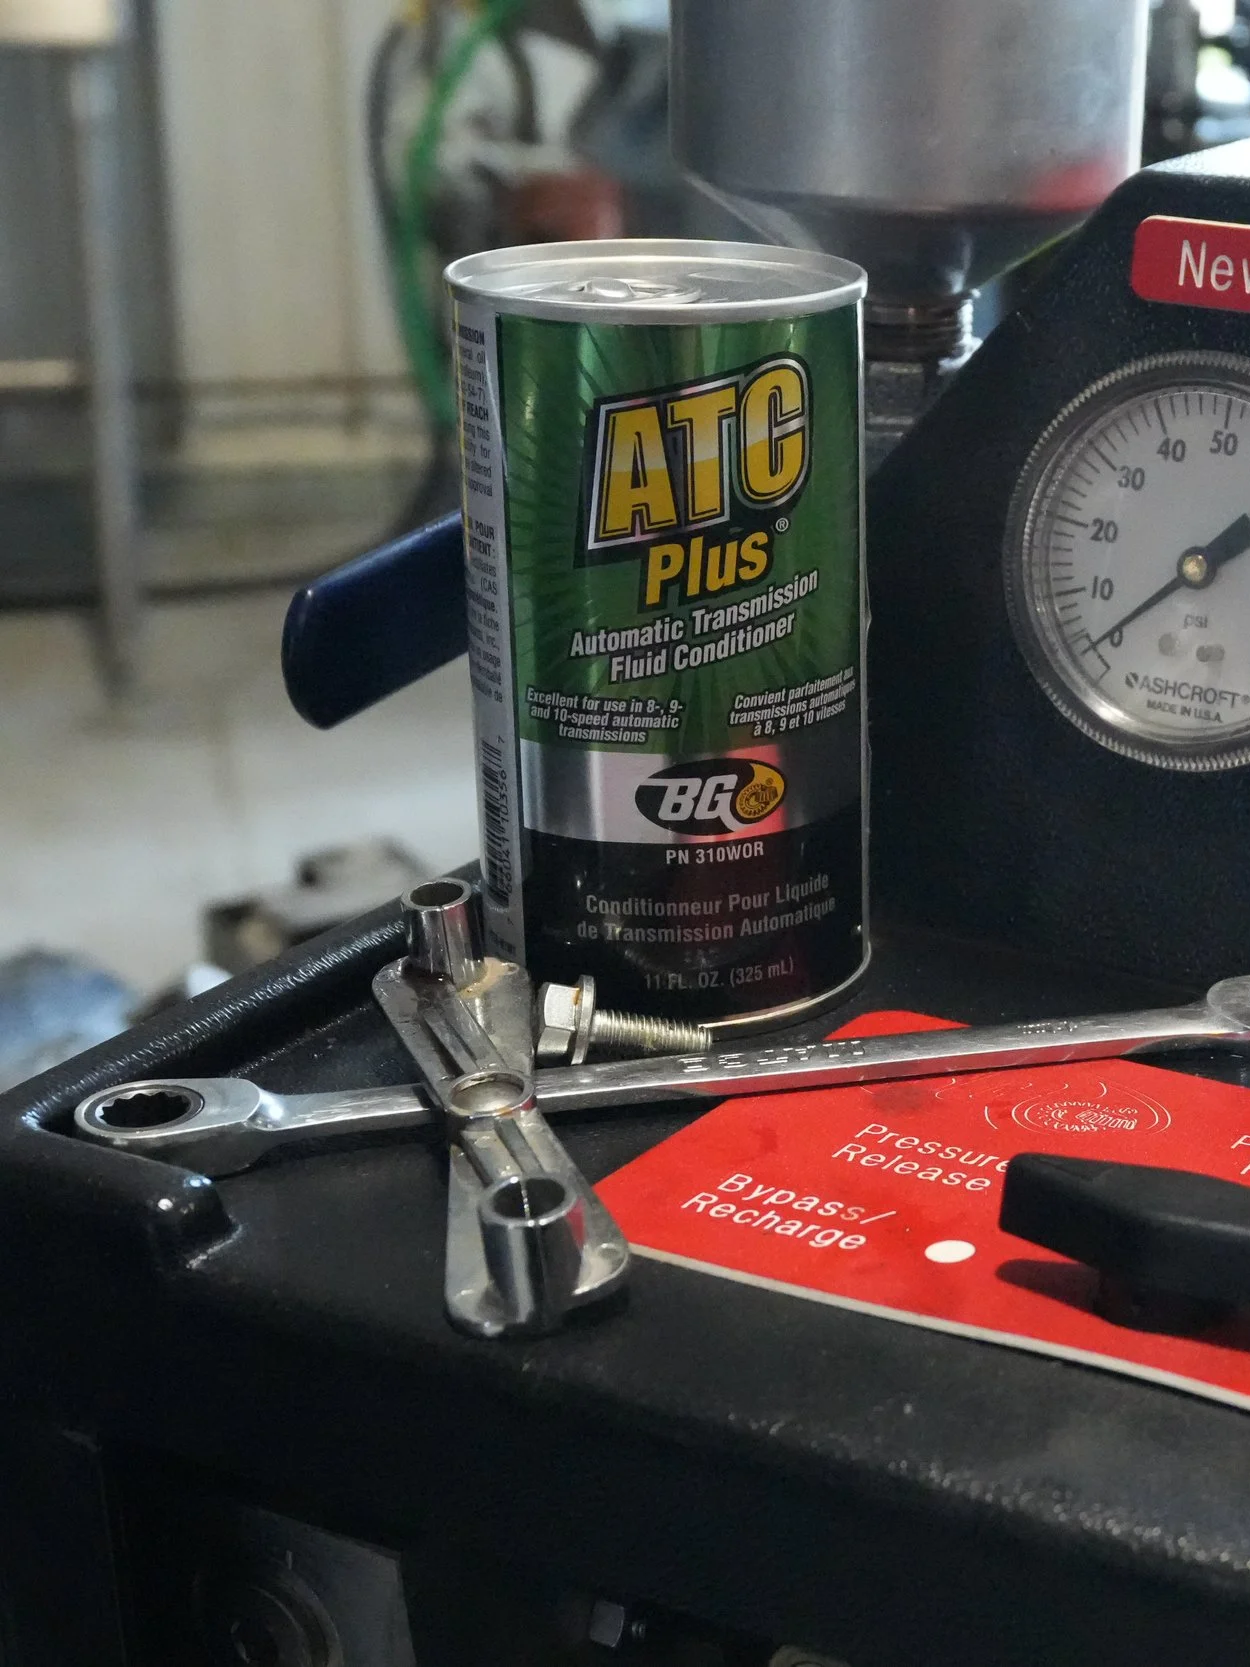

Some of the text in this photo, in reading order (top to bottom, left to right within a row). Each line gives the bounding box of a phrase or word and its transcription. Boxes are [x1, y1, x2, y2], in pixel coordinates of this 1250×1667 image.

[588, 358, 809, 551] ATC
[1156, 437, 1187, 463] 40
[1209, 430, 1239, 456] 50
[1117, 465, 1146, 491] 30
[1090, 517, 1119, 543] 20
[644, 529, 770, 606] Plus
[1091, 575, 1114, 601] 10
[570, 569, 819, 657] Automatic Transmission
[610, 611, 796, 683] Fluid Conditioner
[1108, 626, 1124, 648] 0
[527, 687, 683, 715] Excellent for use in 8-, 9-
[734, 688, 786, 710] Convient
[788, 669, 843, 704] parfaitement
[1138, 674, 1241, 709] ASHCROFT
[530, 704, 680, 729] and 10-speed automatic
[729, 699, 807, 725] transmissions
[753, 699, 846, 737] à 8, 9 et 10 vitesses
[1146, 699, 1177, 715] MADE
[1180, 705, 1193, 717] IN
[558, 724, 647, 742] transmissions
[640, 773, 740, 833] BG
[666, 841, 764, 865] PN 310WOR
[586, 872, 829, 917] Conditionneur Pour Liquide
[577, 896, 836, 943] de Transmission Automatique
[644, 956, 795, 990] 11 FL. OZ. (325 mL)
[855, 1123, 1012, 1174] Pressure
[832, 1142, 992, 1192] Release
[717, 1173, 897, 1225] Bypass/
[681, 1191, 868, 1250] Recharge
